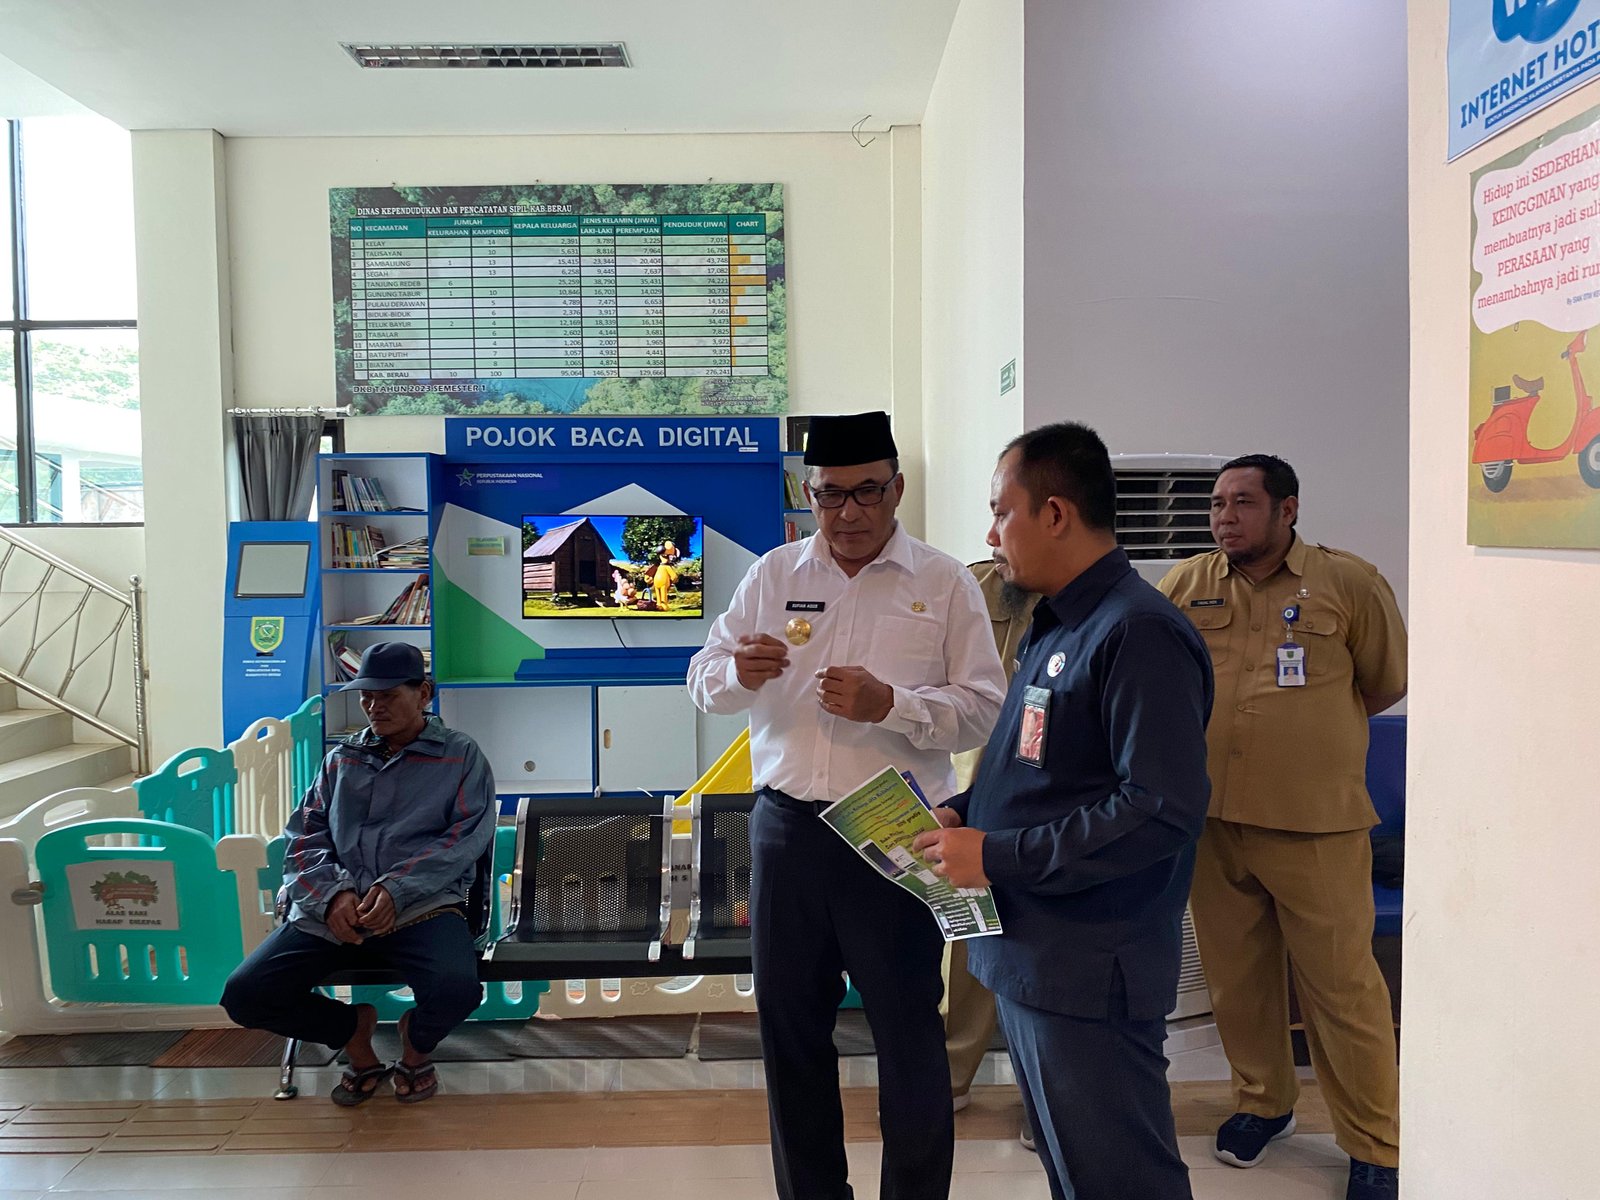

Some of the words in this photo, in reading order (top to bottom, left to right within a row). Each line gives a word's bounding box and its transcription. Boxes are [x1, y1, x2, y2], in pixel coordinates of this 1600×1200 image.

[1461, 52, 1548, 128] INTERNET
[1554, 19, 1600, 70] HOT
[1483, 183, 1514, 205] Hidup
[1516, 170, 1530, 191] ini
[1532, 139, 1600, 183] SEDERHAN
[357, 208, 380, 216] DINAS
[382, 206, 441, 215] KEPENDUDUKAN
[442, 206, 458, 214] DAN
[460, 206, 508, 214] PENCATATAN
[509, 205, 528, 213] SIPIL
[1492, 182, 1567, 227] KEINGGINAN
[1569, 172, 1600, 200] yang
[1484, 222, 1551, 256] membuatnya
[1553, 208, 1577, 234] jadi
[1497, 243, 1557, 277] PERASAAN
[1560, 235, 1591, 261] yang
[1478, 276, 1554, 309] menambahnya
[1556, 264, 1579, 290] jadi
[466, 427, 556, 447] POJOK
[571, 427, 644, 447] BACA
[658, 427, 758, 446] DIGITAL
